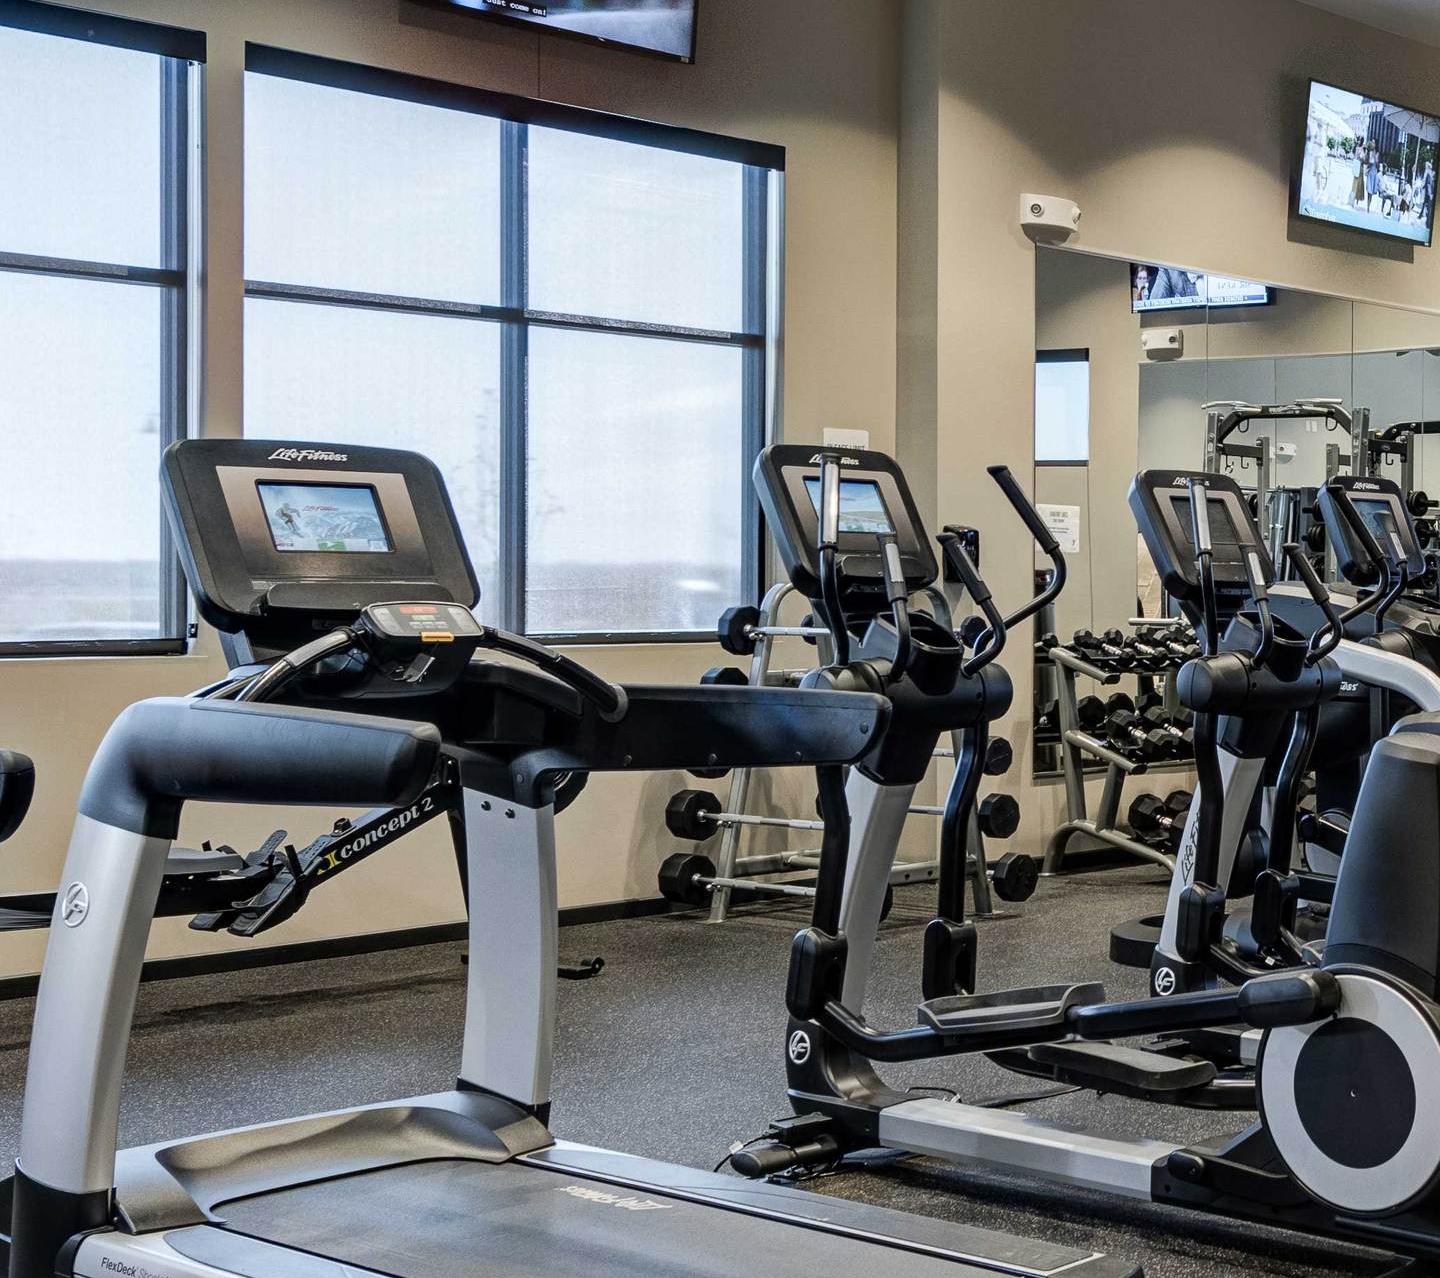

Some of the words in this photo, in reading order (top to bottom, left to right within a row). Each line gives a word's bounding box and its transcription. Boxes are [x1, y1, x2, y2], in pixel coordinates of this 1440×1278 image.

[340, 807, 421, 860] concept
[422, 796, 435, 812] 2
[101, 1256, 136, 1278] FlexDeck
